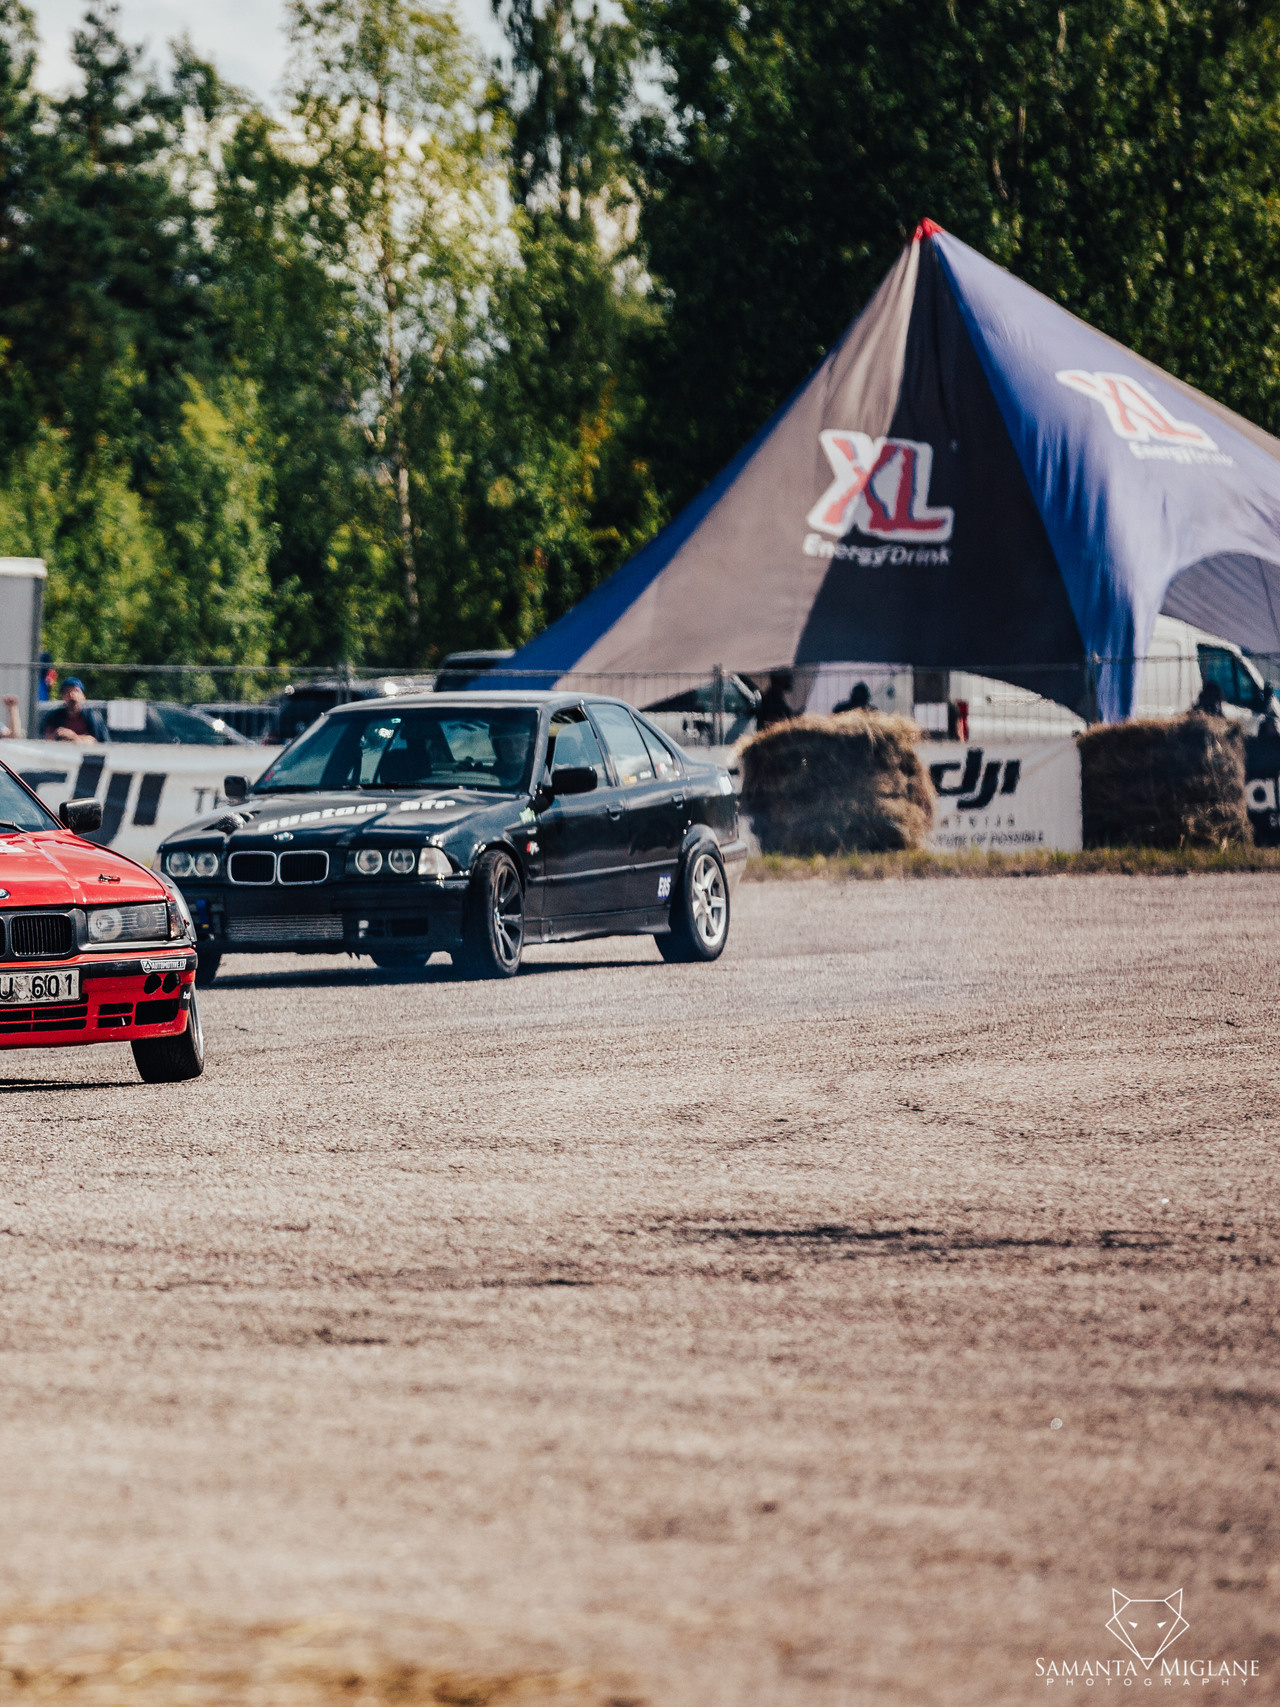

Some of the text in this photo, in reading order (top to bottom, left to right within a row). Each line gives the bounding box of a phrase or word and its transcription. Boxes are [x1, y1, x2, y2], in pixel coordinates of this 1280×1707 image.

[1056, 369, 1218, 450] XL
[808, 429, 954, 543] XL
[31, 973, 73, 999] 601
